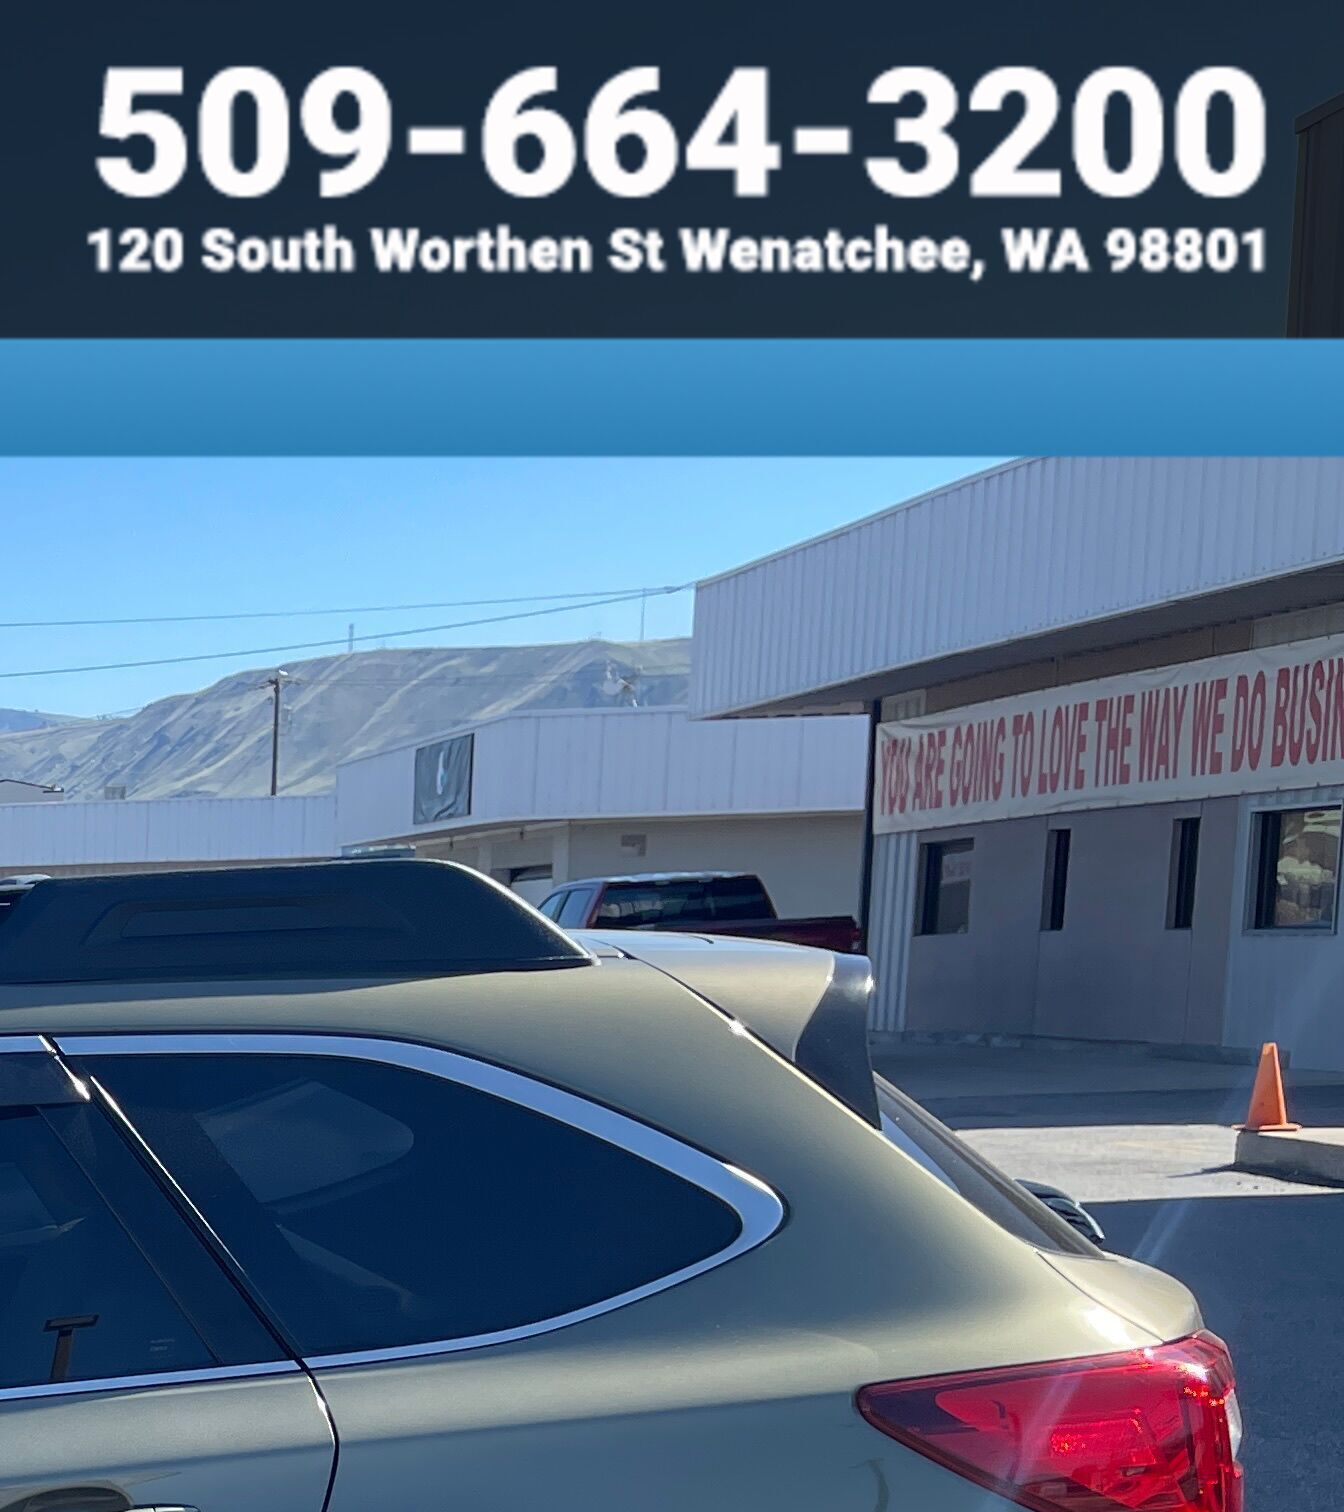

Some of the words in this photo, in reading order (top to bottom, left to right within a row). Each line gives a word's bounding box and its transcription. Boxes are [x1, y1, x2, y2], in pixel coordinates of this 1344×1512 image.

[881, 736, 911, 816] YOU
[912, 730, 946, 811] ARE
[950, 716, 1006, 807] GOING
[1011, 711, 1034, 798] TO
[1038, 702, 1089, 795] LOVE
[1094, 695, 1135, 788] THE
[1138, 684, 1188, 783] WAY
[1191, 678, 1228, 777] WE
[1231, 670, 1266, 772] DO
